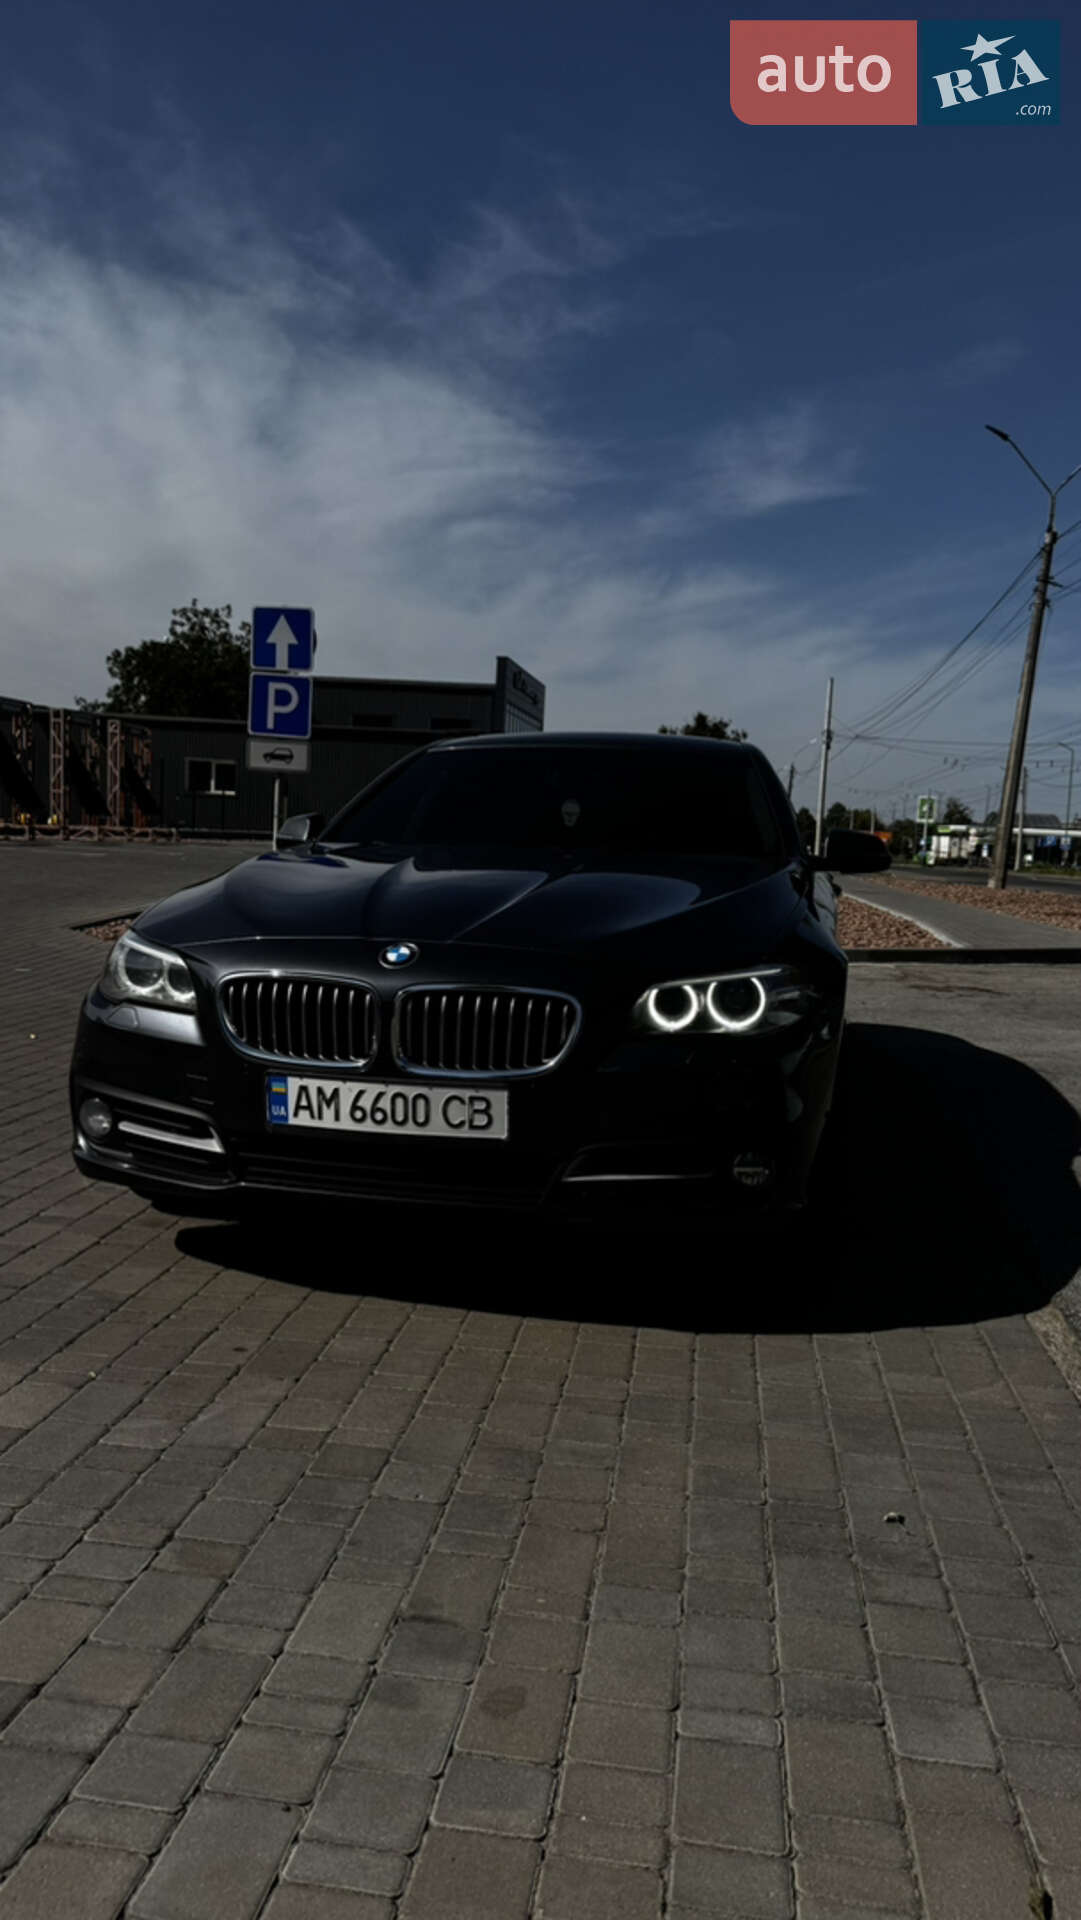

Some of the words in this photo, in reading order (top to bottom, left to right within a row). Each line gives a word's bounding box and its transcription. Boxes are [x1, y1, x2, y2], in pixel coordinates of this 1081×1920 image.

[266, 680, 300, 731] P
[271, 1105, 287, 1117] UA
[293, 1084, 340, 1122] AM
[349, 1089, 430, 1127] 6600
[442, 1094, 493, 1130] CB
